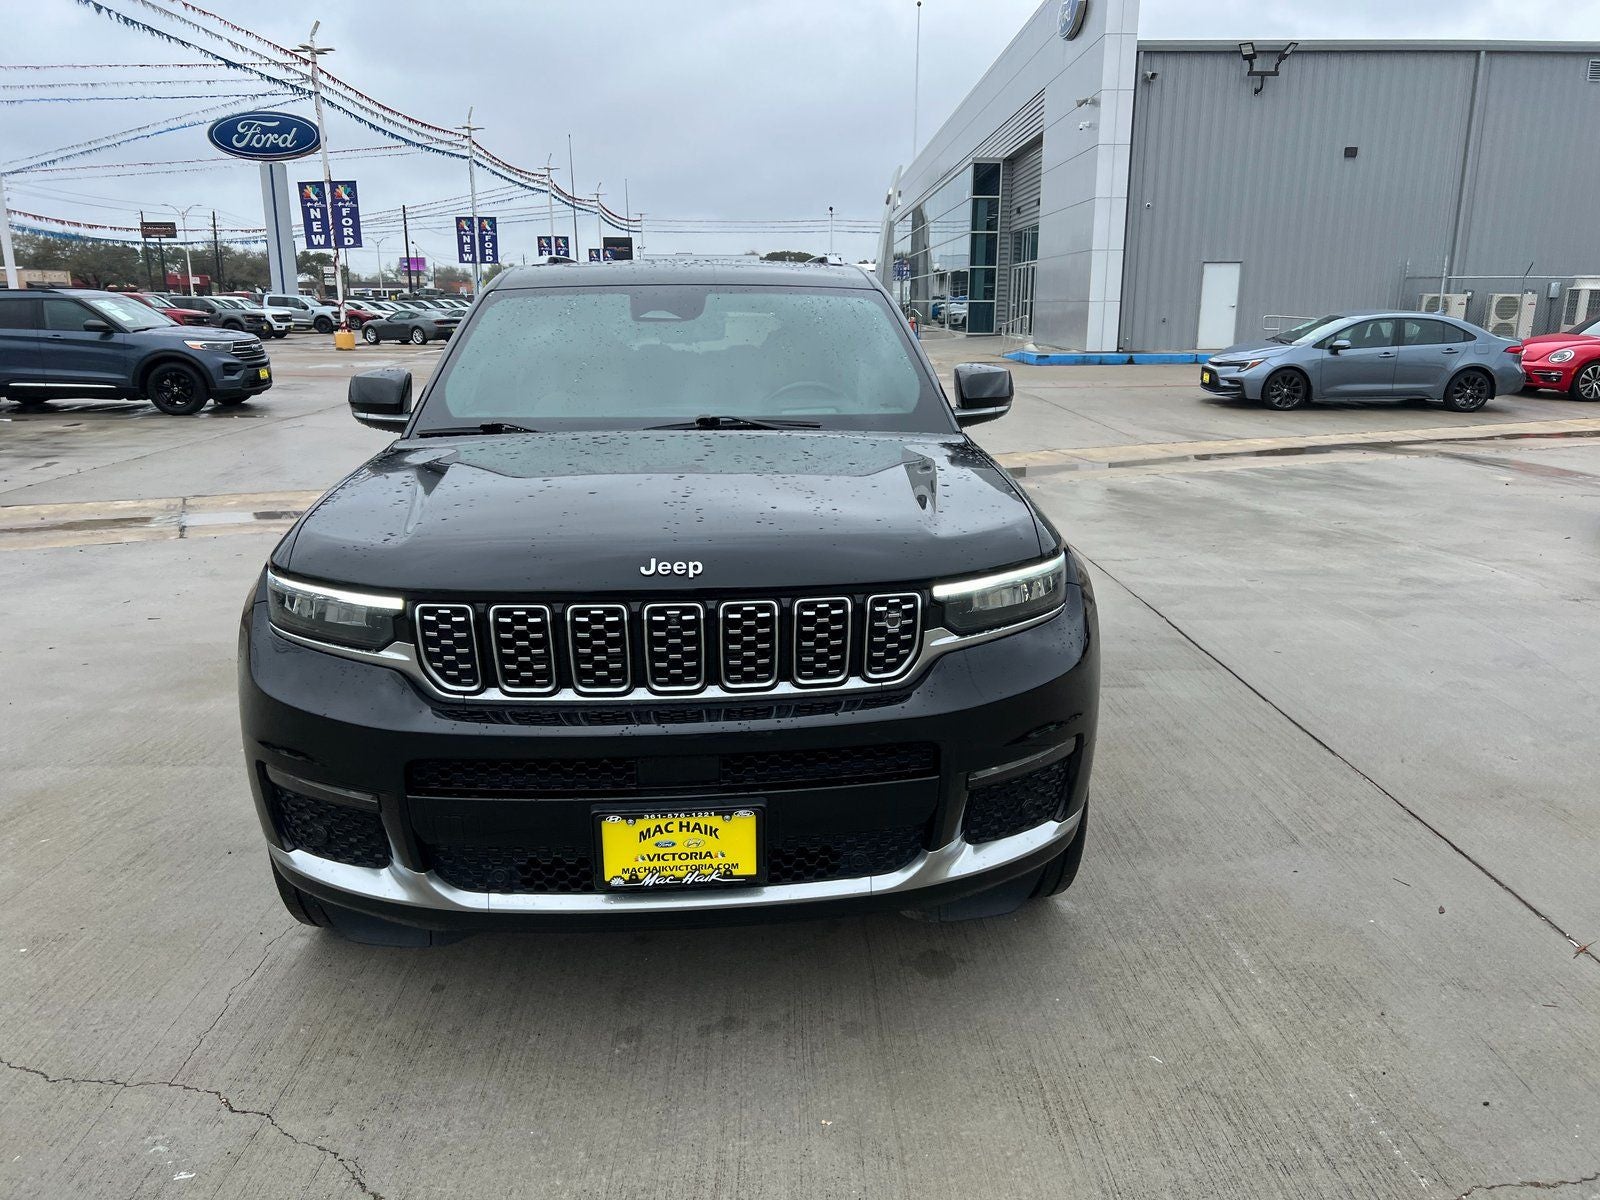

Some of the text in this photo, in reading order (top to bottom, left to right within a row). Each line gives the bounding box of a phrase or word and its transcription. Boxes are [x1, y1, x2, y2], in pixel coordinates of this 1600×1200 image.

[232, 120, 297, 148] Ford
[309, 208, 326, 245] NEW
[341, 208, 354, 245] FORD
[462, 235, 473, 261] NEW
[484, 235, 494, 262] FORD
[640, 558, 703, 578] Jeep
[638, 820, 720, 843] MAC HAIK
[646, 851, 715, 862] VICTORIA
[621, 863, 739, 875] MACHAIKVICTORIA.COM
[640, 870, 723, 886] Mac Haik
